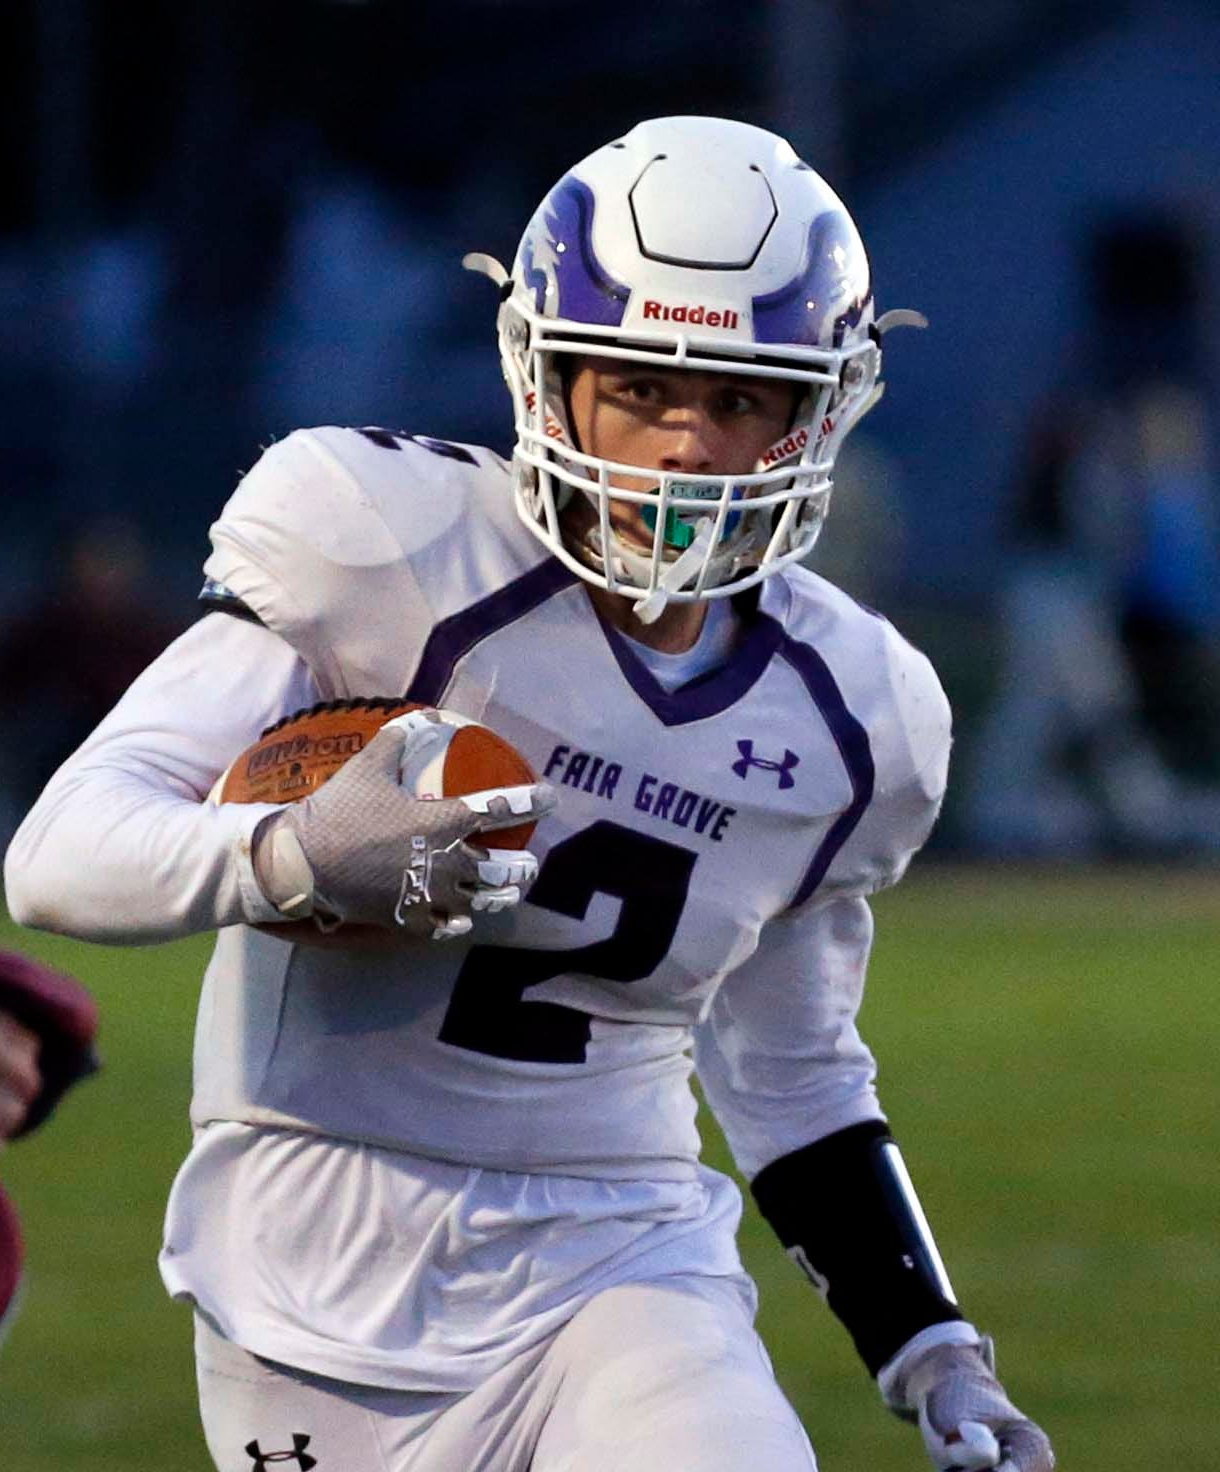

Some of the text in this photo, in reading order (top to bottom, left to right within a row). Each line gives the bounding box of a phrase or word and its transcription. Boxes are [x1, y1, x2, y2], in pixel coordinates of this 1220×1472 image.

[643, 300, 739, 329] Riddell
[762, 417, 835, 466] Riddll
[542, 744, 738, 842] FAIR GROVE
[437, 818, 700, 1064] 2
